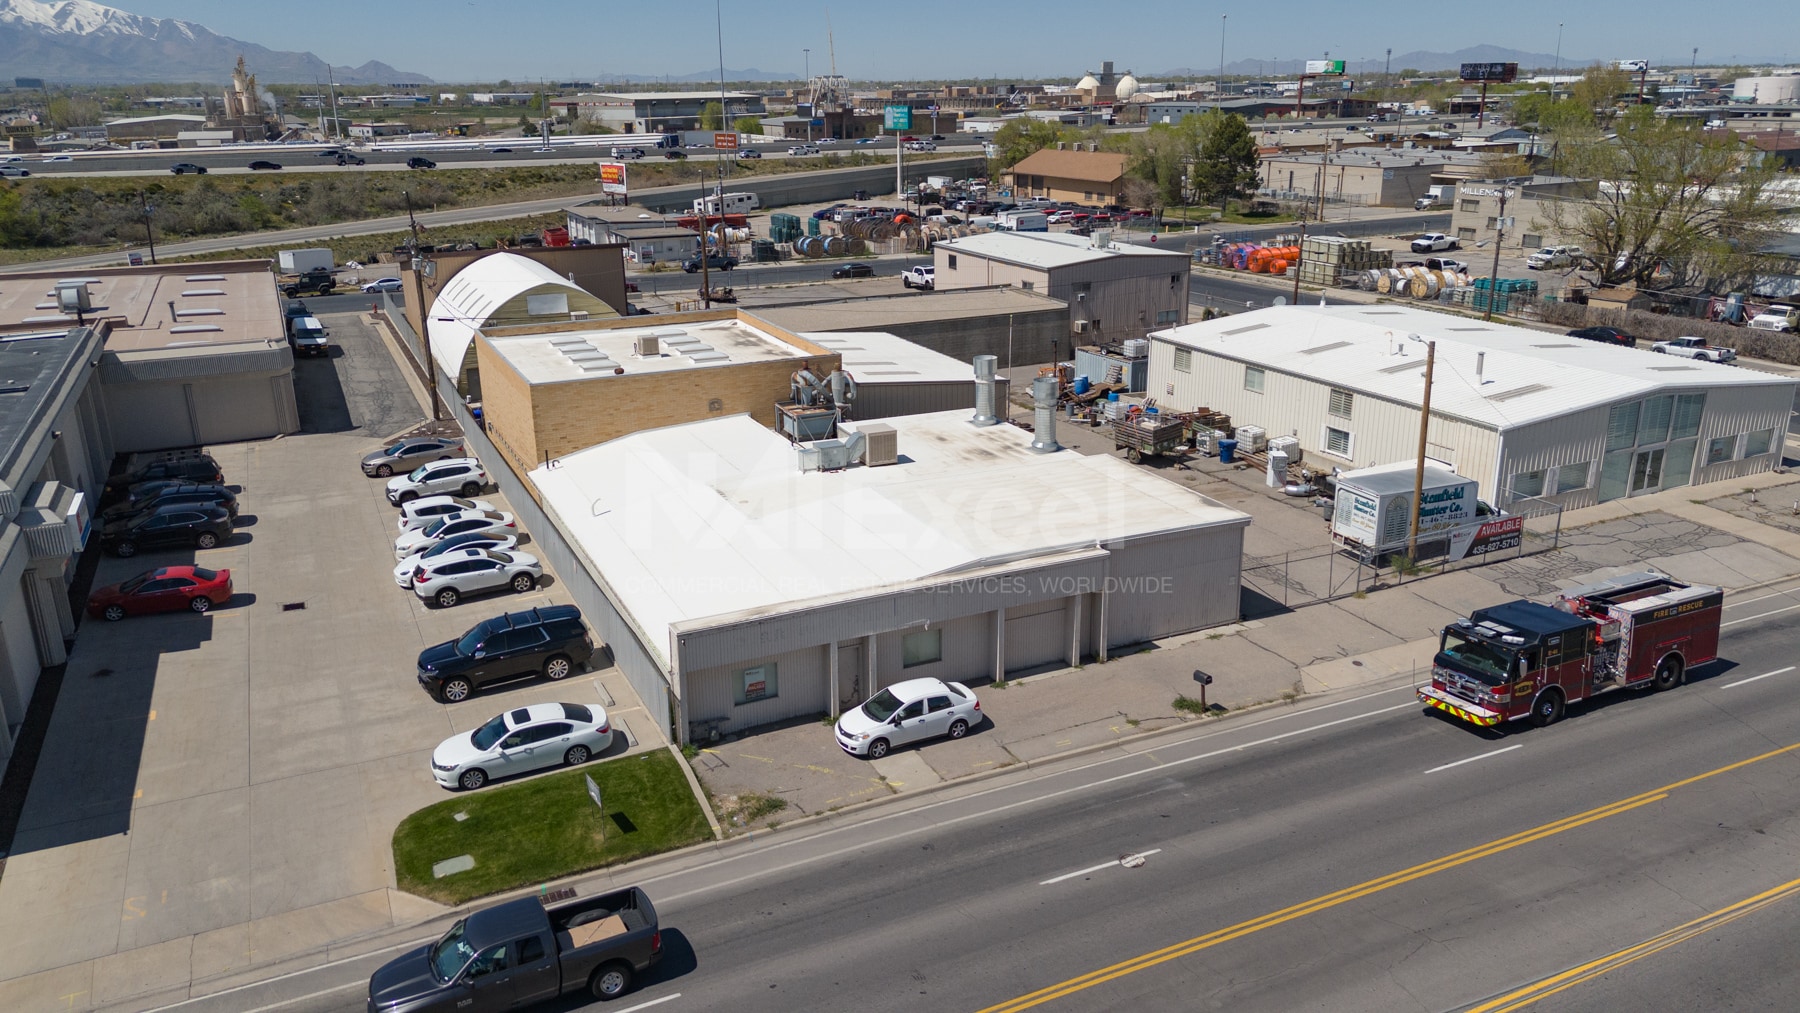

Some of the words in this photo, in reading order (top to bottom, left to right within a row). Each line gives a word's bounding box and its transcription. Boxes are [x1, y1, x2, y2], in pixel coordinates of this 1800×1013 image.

[1449, 502, 1463, 513] Co.
[1481, 518, 1521, 536] AVAILABLE
[1472, 537, 1519, 555] 435-627-5710
[1653, 608, 1669, 619] FIRE
[1678, 600, 1704, 613] RESCUE
